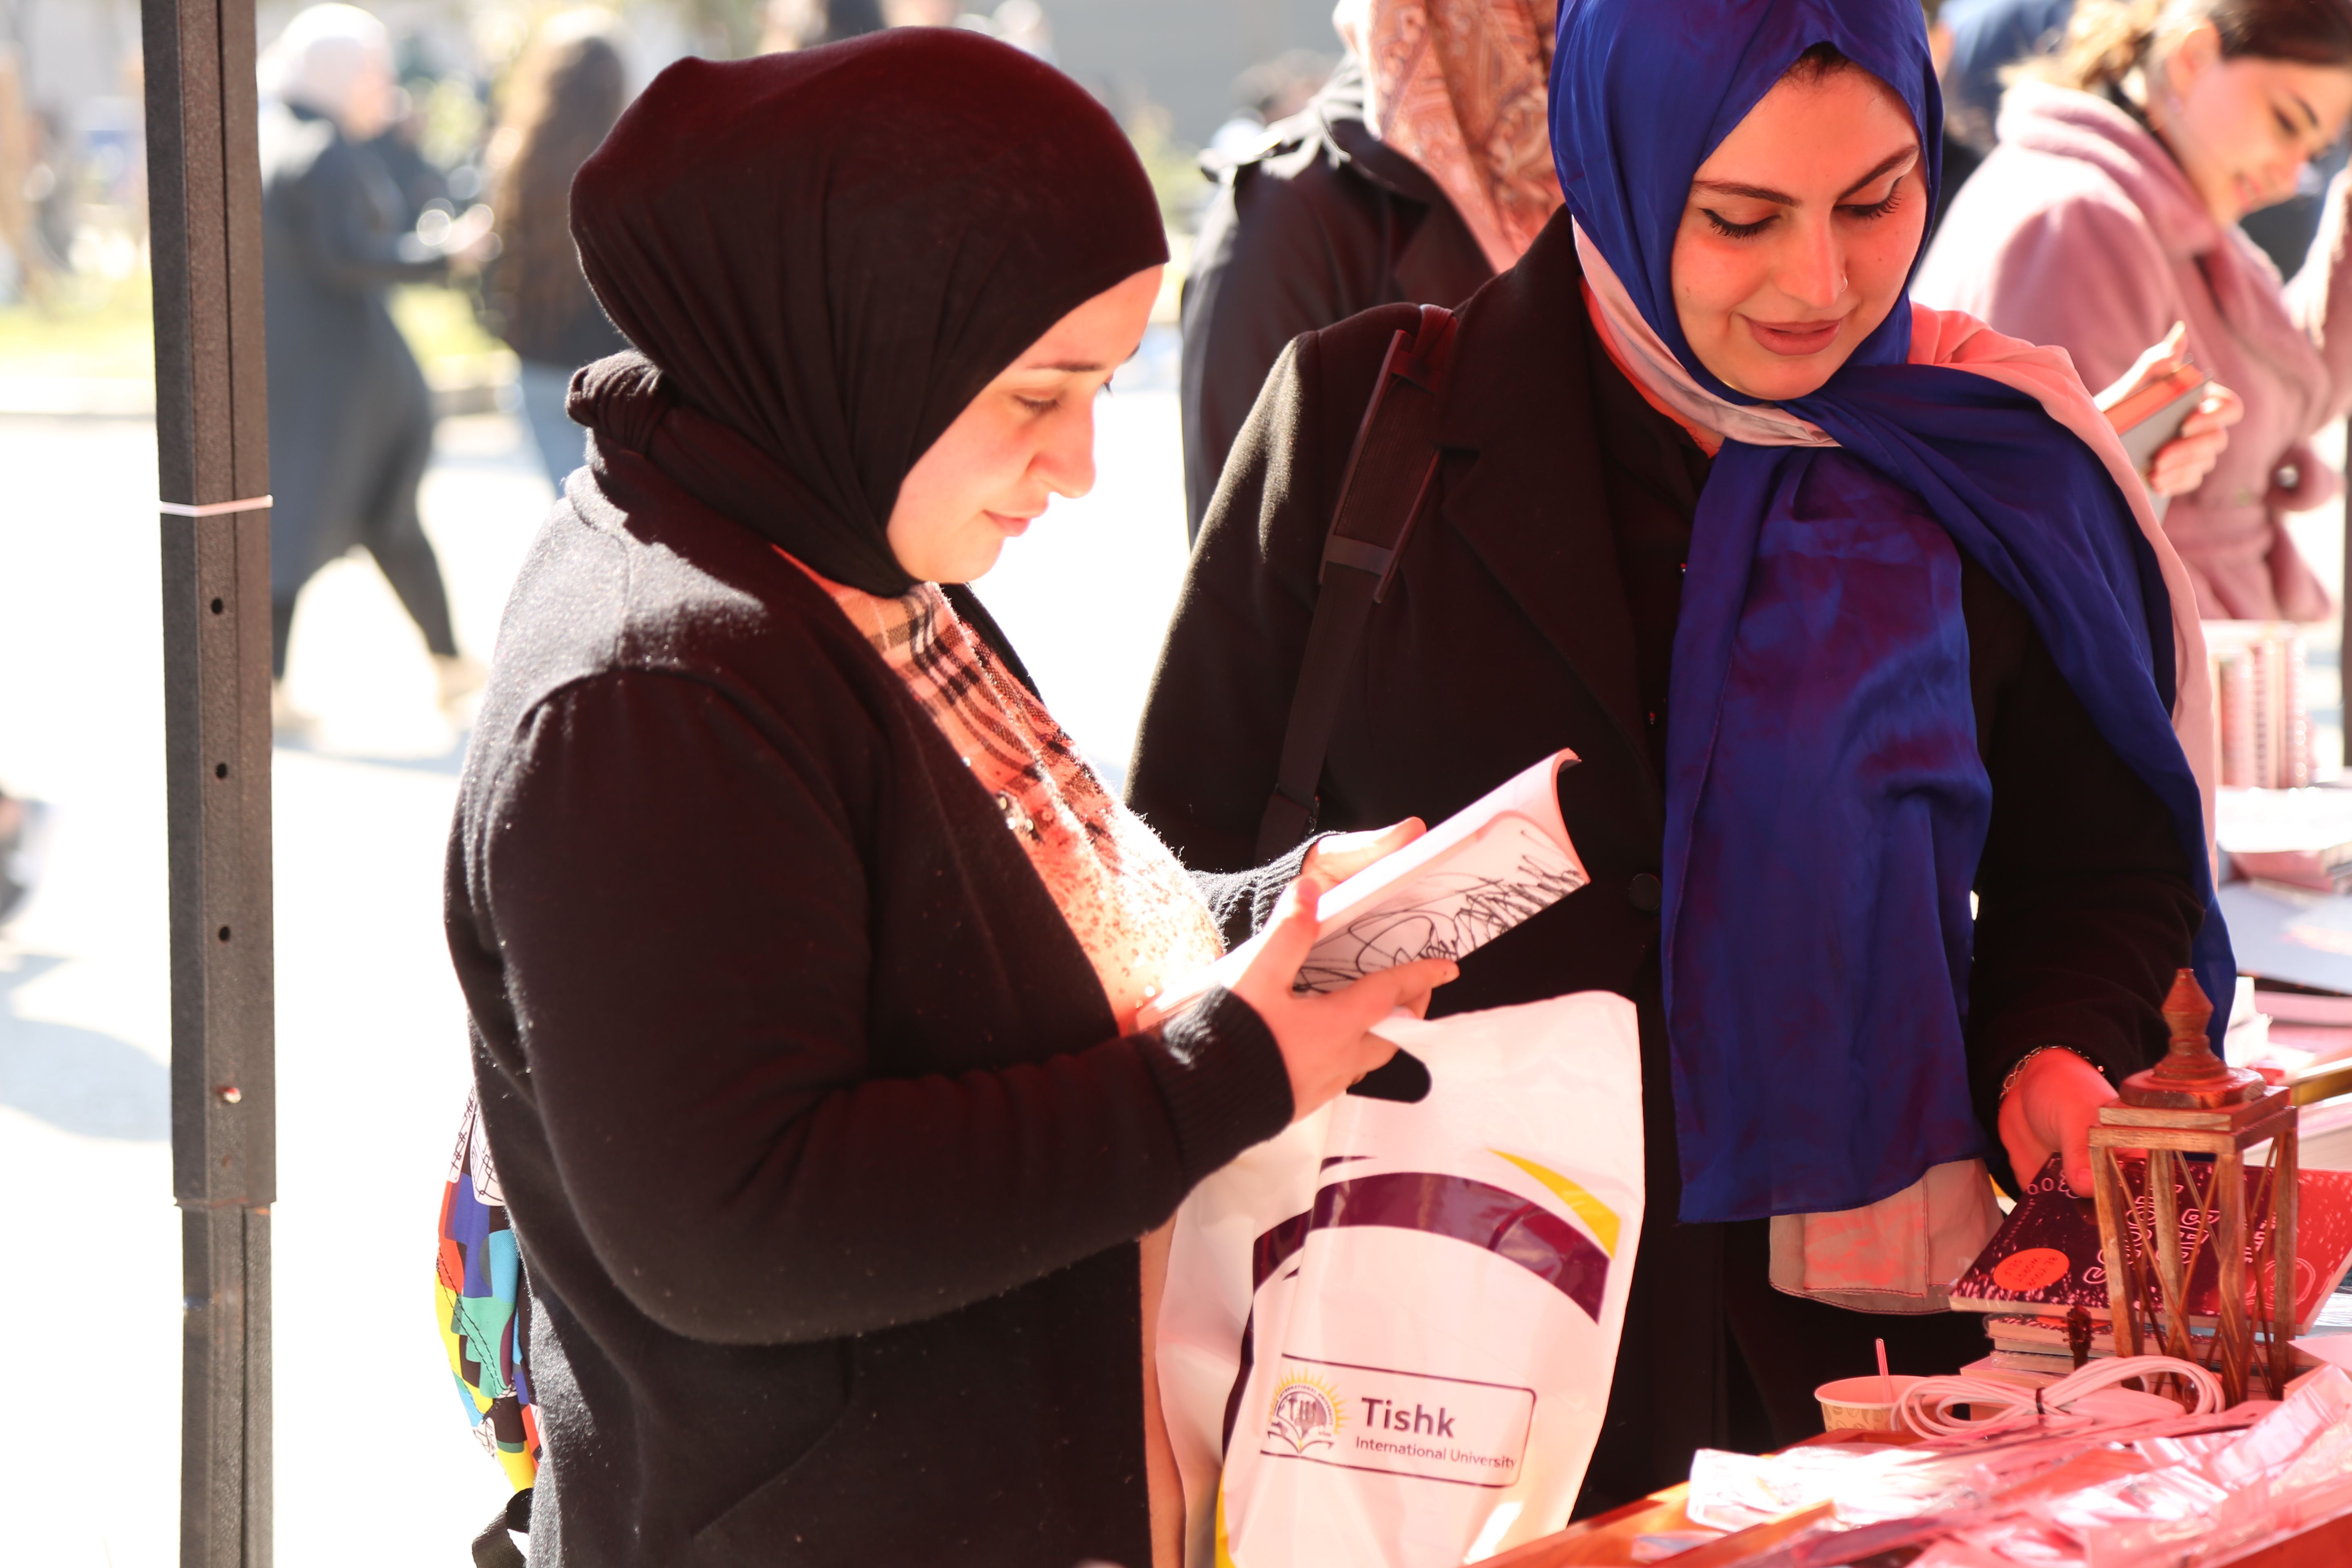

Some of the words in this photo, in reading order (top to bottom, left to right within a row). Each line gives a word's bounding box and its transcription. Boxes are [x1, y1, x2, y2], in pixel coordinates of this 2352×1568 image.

[2004, 1259, 2022, 1276] SELF
[2013, 1258, 2041, 1283] WORST
[2043, 1256, 2058, 1266] BE
[2025, 1267, 2049, 1287] YOUR
[1361, 1396, 1457, 1439] Tishk
[1356, 1436, 1447, 1461] International
[1450, 1449, 1518, 1470] University
